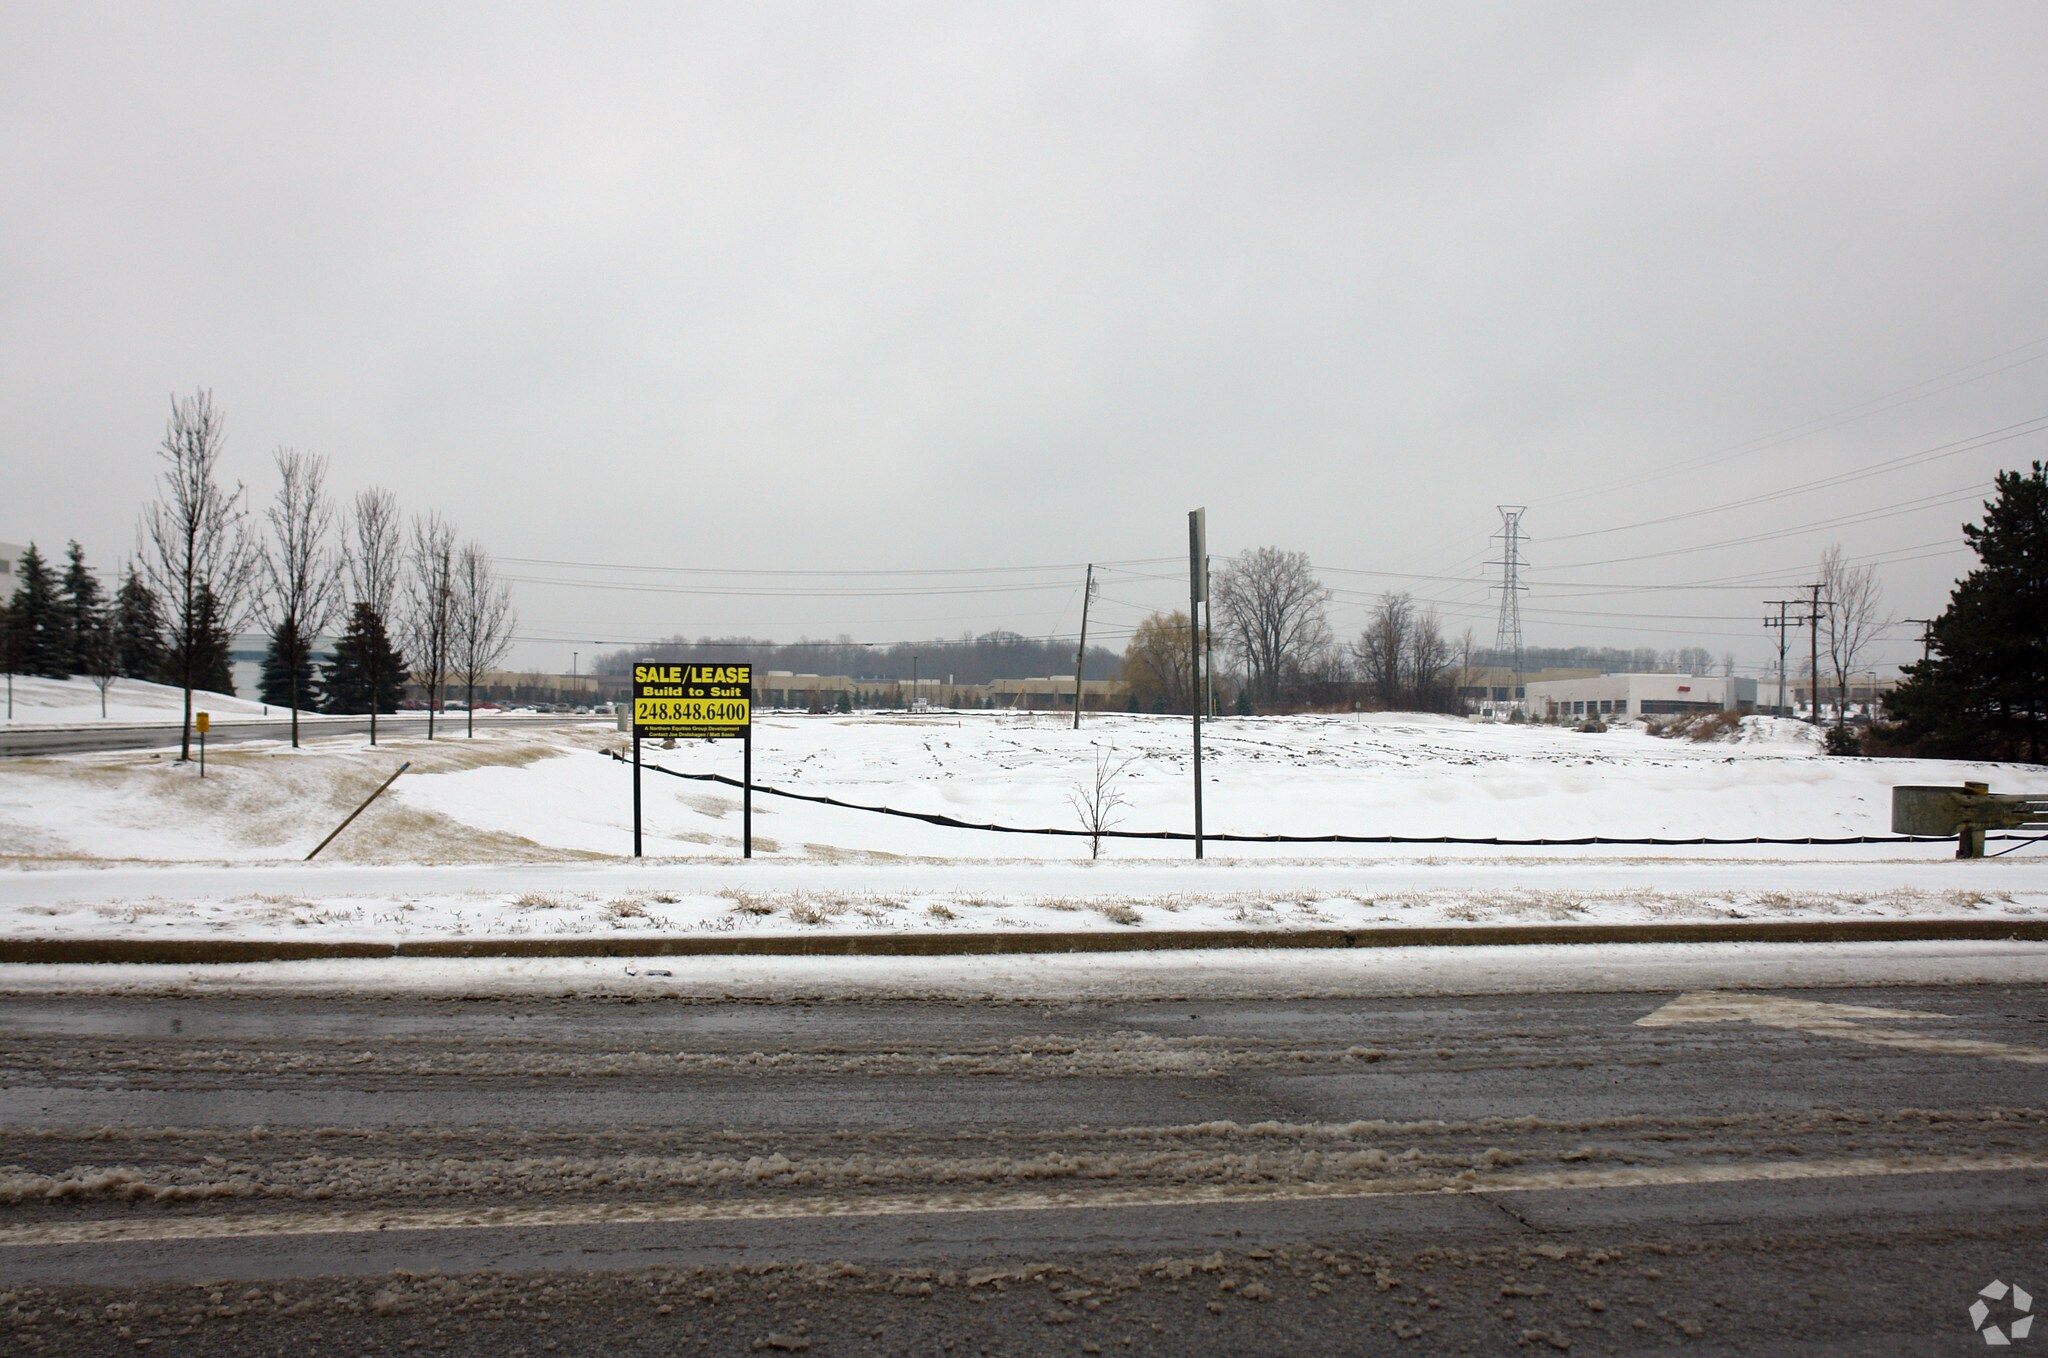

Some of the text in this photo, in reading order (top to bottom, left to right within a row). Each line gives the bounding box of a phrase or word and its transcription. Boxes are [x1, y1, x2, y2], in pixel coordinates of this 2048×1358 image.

[635, 665, 750, 685] SALE/LEASE
[643, 686, 741, 697] Build to Suit
[639, 702, 745, 720] 248.848.6400
